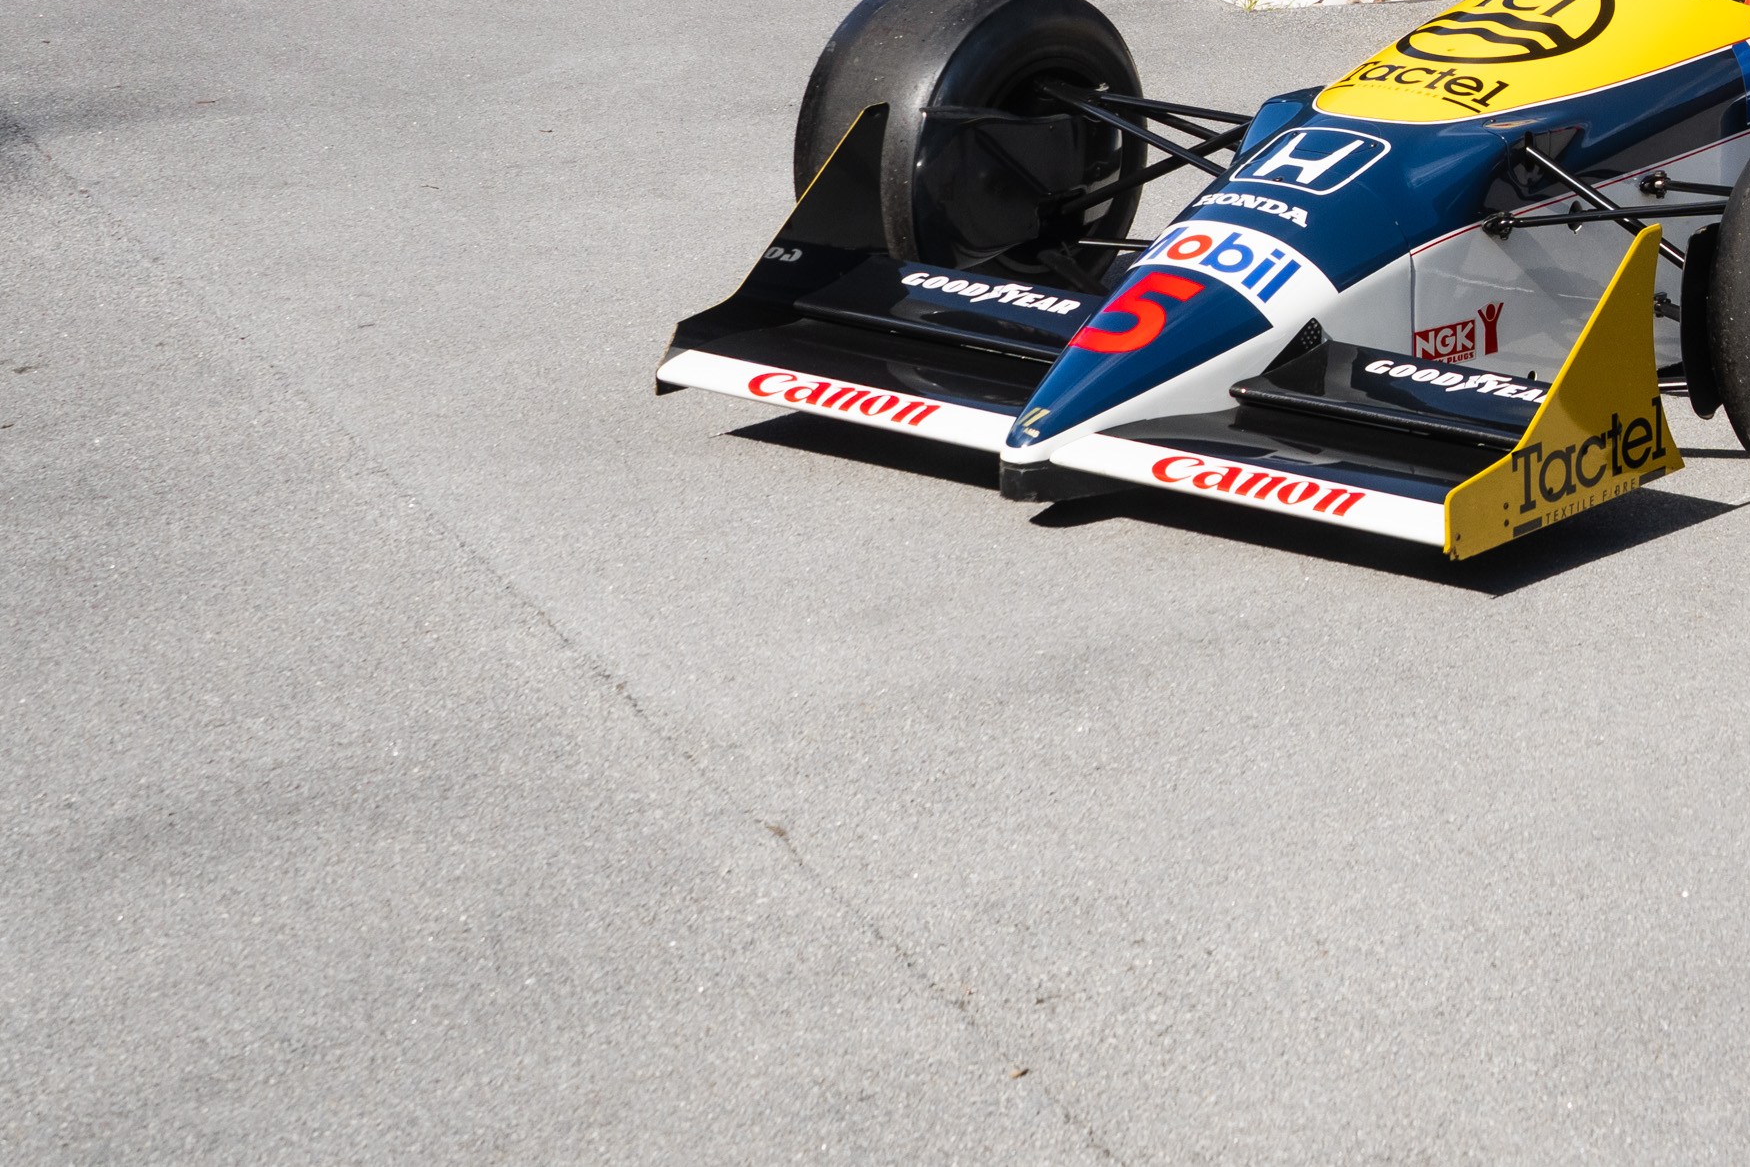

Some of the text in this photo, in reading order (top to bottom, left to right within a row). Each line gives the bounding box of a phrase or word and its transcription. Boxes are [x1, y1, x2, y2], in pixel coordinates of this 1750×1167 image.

[1192, 192, 1309, 228] HONDA
[900, 271, 1081, 316] GOODYEAR
[1069, 271, 1206, 354] 5
[1415, 321, 1474, 358] NGK
[747, 371, 942, 427] Canon
[1511, 395, 1667, 515] Tactel
[1151, 455, 1366, 517] Canon
[1545, 477, 1636, 525] TEXTILE FIBRE
